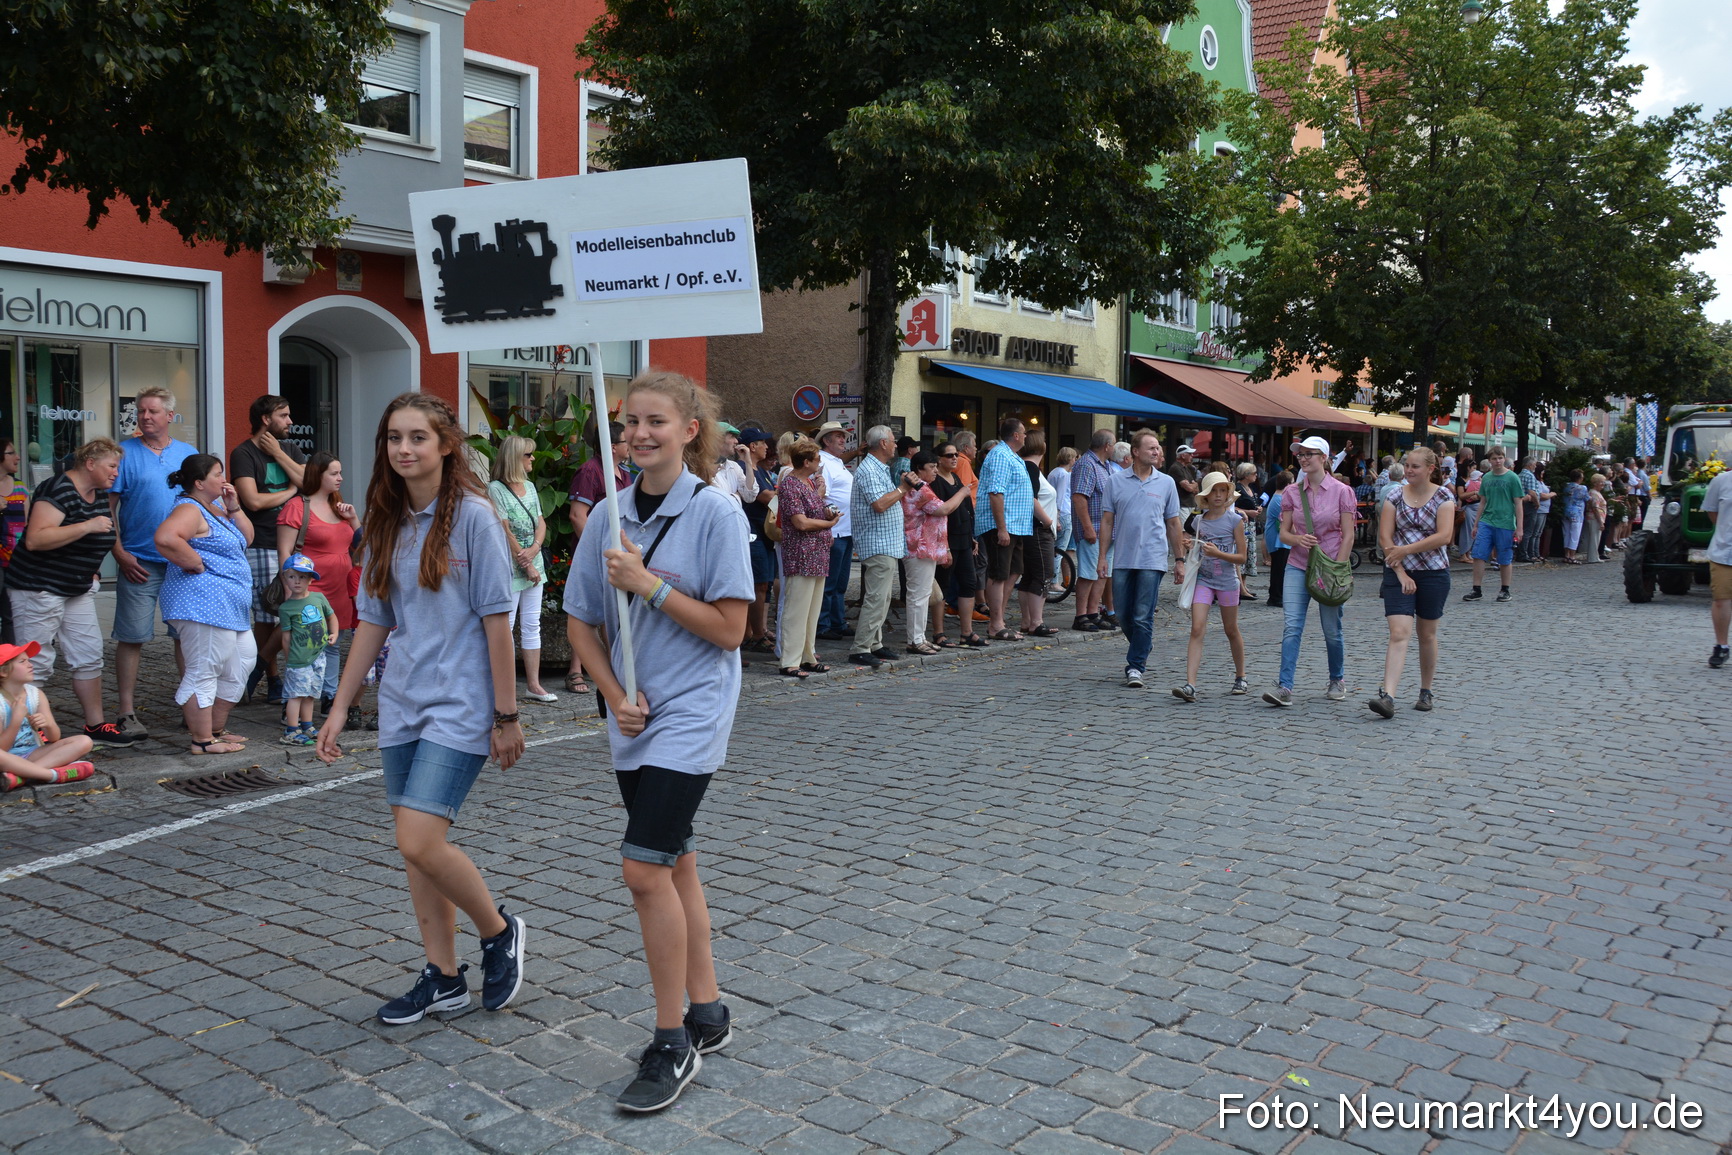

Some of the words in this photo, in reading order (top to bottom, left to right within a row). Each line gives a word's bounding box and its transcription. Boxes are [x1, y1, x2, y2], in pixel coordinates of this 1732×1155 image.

[585, 274, 659, 293] Neumarkt
[664, 274, 671, 290] /
[676, 271, 709, 288] Opf.
[713, 269, 743, 284] e.V.
[952, 327, 1002, 356] STADT
[1006, 337, 1079, 366] APOTHEKE
